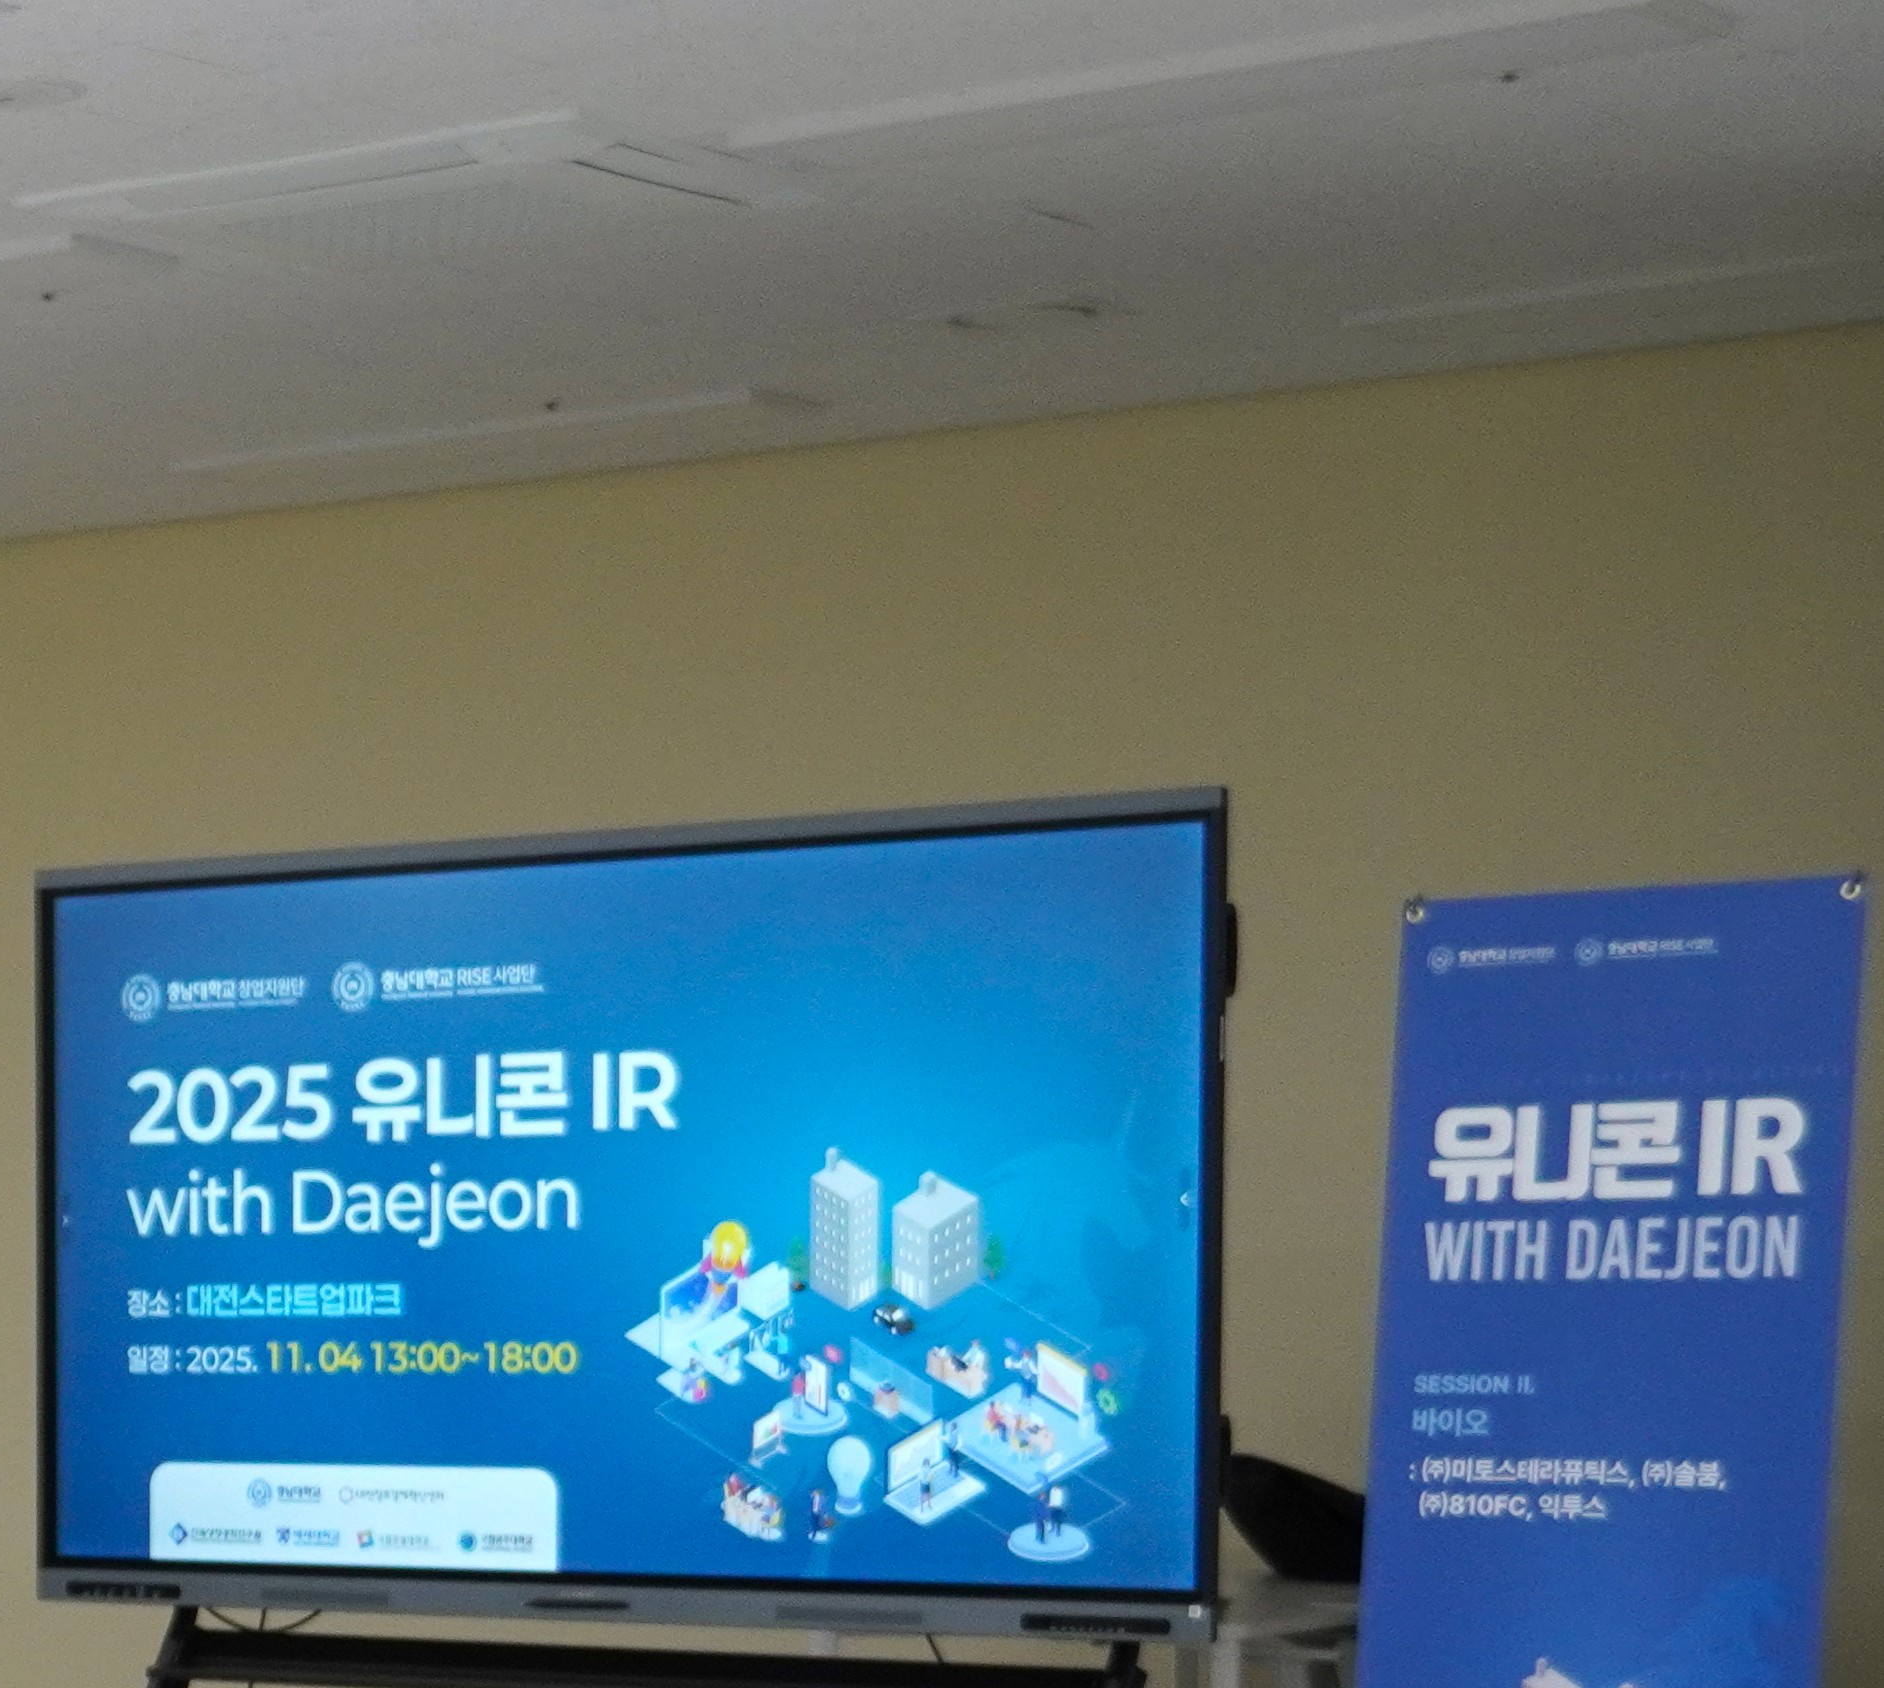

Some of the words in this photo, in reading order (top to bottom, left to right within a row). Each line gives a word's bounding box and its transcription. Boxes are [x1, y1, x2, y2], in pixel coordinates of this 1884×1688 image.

[166, 979, 235, 1002] 충남대학교
[381, 969, 453, 992] 충남대학교
[456, 966, 491, 988] RISE
[493, 964, 537, 984] 사업단
[128, 1063, 332, 1145] 2025
[352, 1050, 570, 1143] 유니콘
[592, 1050, 679, 1132] IR
[1428, 1100, 1681, 1203] 유니콘
[1697, 1097, 1806, 1196] IR
[126, 1167, 272, 1237] with
[291, 1163, 582, 1250] Daejeon
[1424, 1218, 1548, 1281] WITH
[1565, 1215, 1799, 1281] DAEJEON
[126, 1288, 172, 1318] 장소
[187, 1282, 402, 1318] 대전스타트업파크
[126, 1345, 170, 1374] 일정
[187, 1346, 258, 1374] 2025.
[266, 1341, 312, 1374] 11.
[318, 1341, 362, 1374] 04
[371, 1340, 578, 1374] 13:00~18:00
[1413, 1374, 1509, 1395] SESSION
[1411, 1408, 1490, 1436] 바이오
[1539, 1495, 1608, 1520] 익투스
